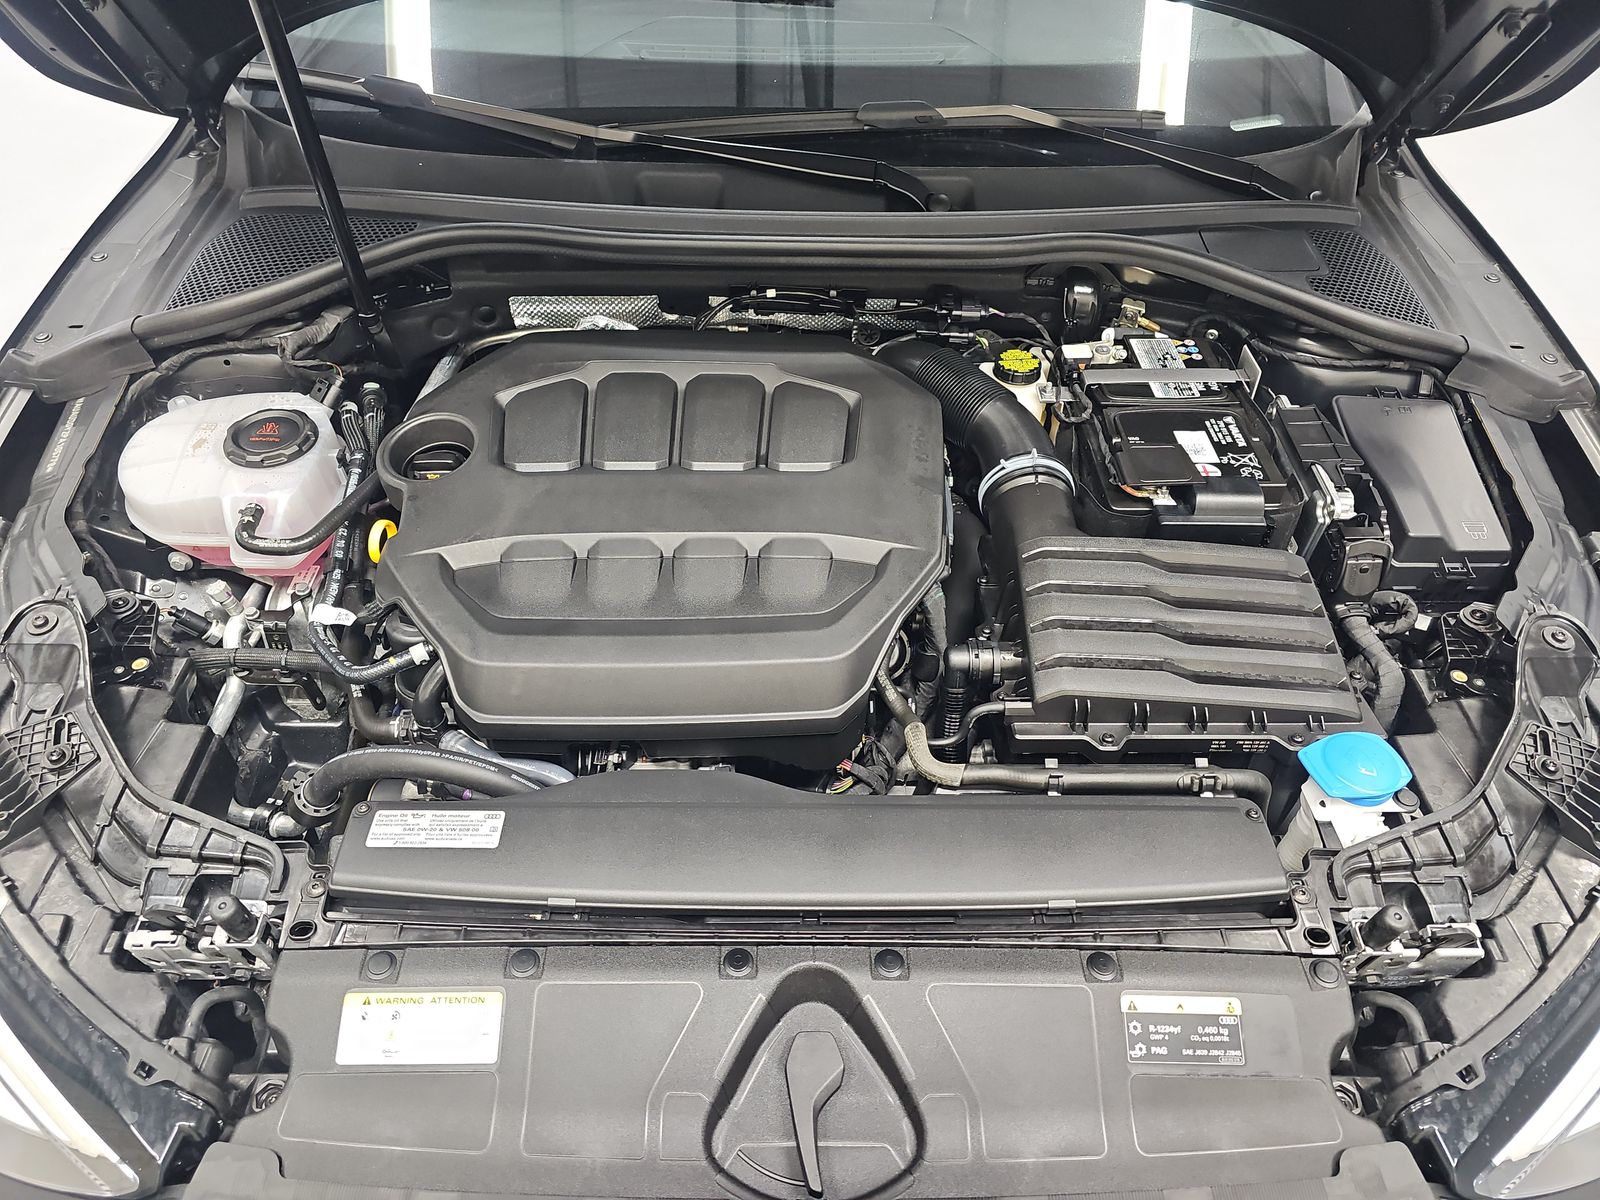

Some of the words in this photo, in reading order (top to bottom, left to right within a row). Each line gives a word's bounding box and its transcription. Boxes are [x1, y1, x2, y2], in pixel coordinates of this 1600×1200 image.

[1228, 424, 1247, 448] VARTA
[375, 997, 424, 1005] WARNING
[430, 996, 486, 1004] ATTENTION
[1149, 1025, 1182, 1035] R-1234yf
[1219, 1026, 1229, 1036] kg
[1150, 1046, 1168, 1055] PAG
